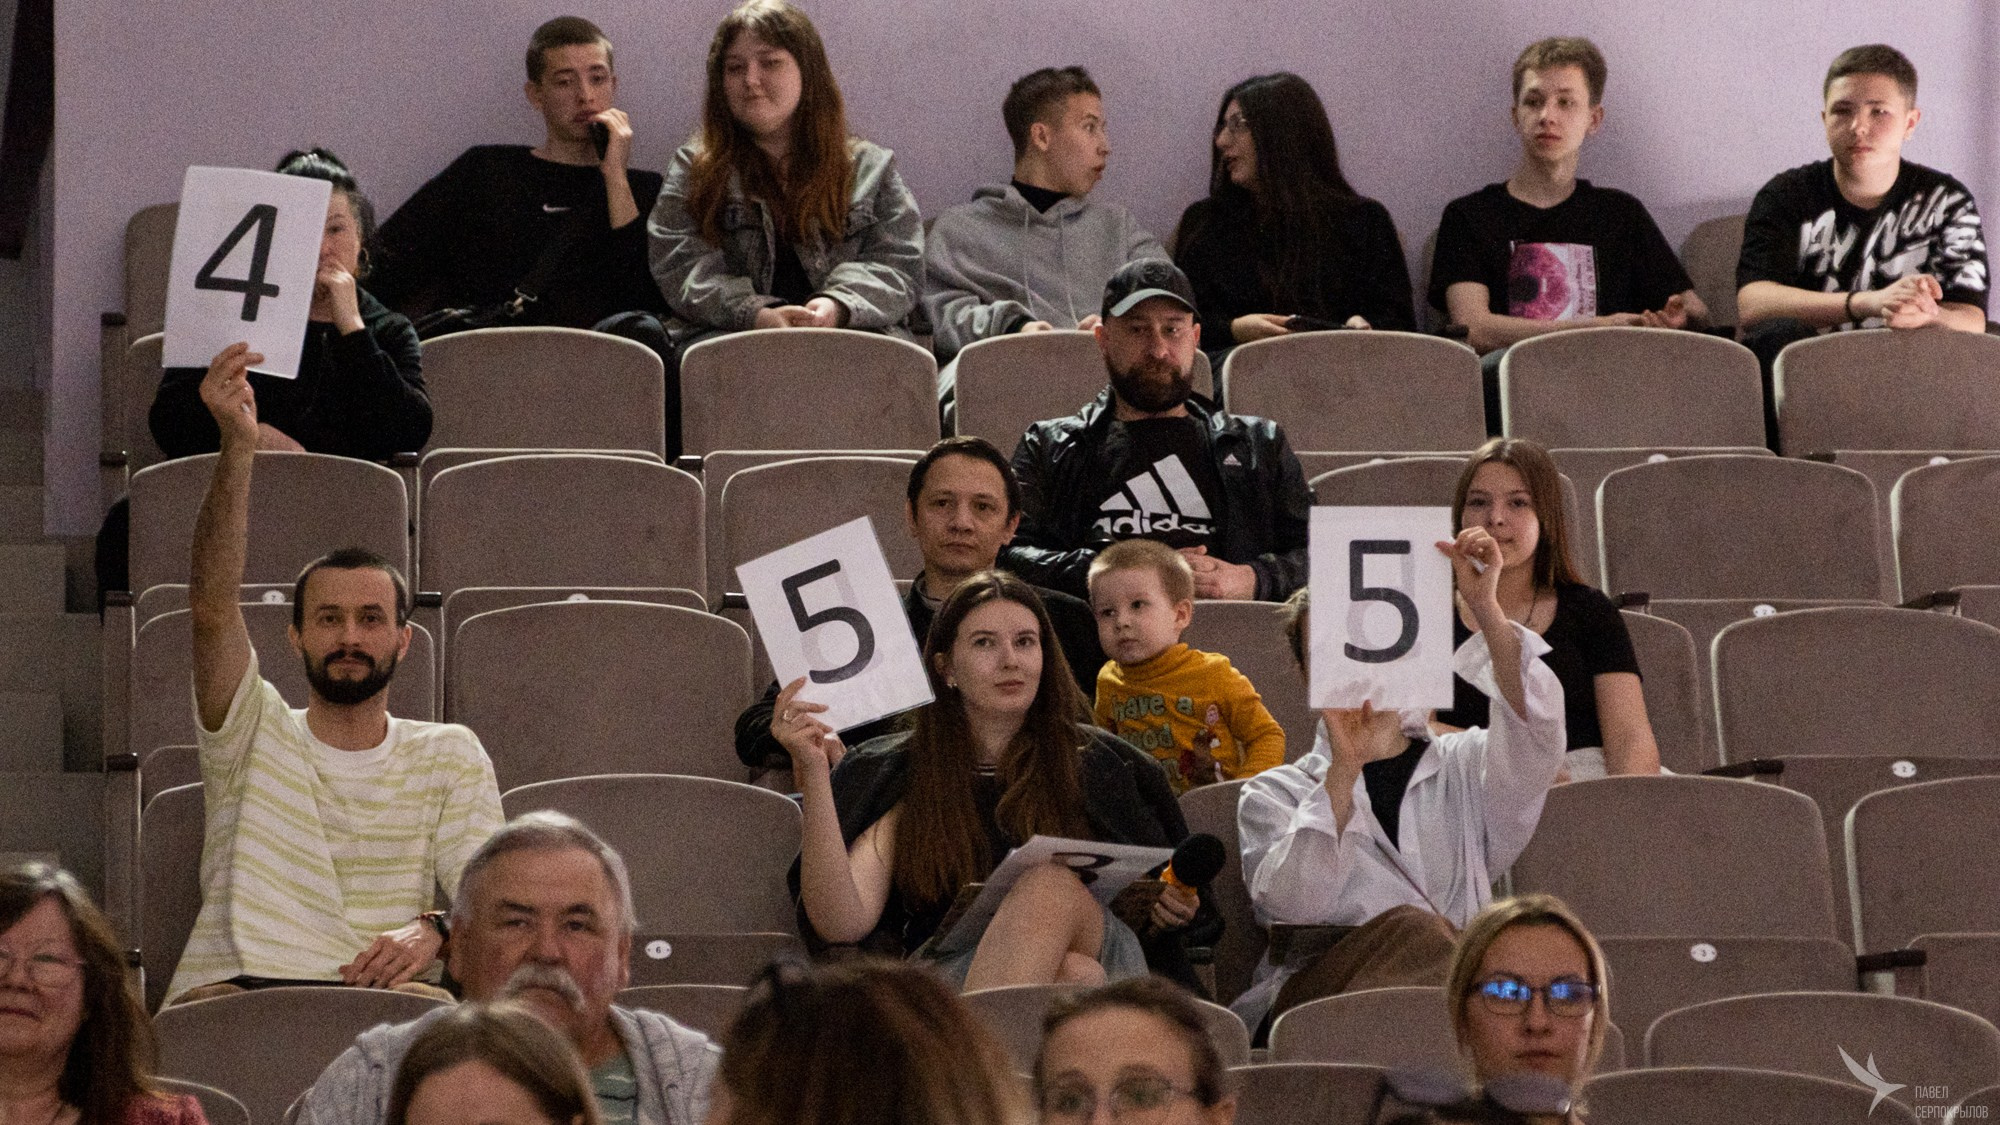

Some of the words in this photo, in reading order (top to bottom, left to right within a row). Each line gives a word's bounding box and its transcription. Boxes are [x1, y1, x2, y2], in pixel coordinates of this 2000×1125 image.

[195, 203, 280, 322] 4
[1092, 509, 1216, 535] adida
[781, 558, 876, 684] 5
[1344, 540, 1419, 664] 5
[1177, 695, 1194, 716] a
